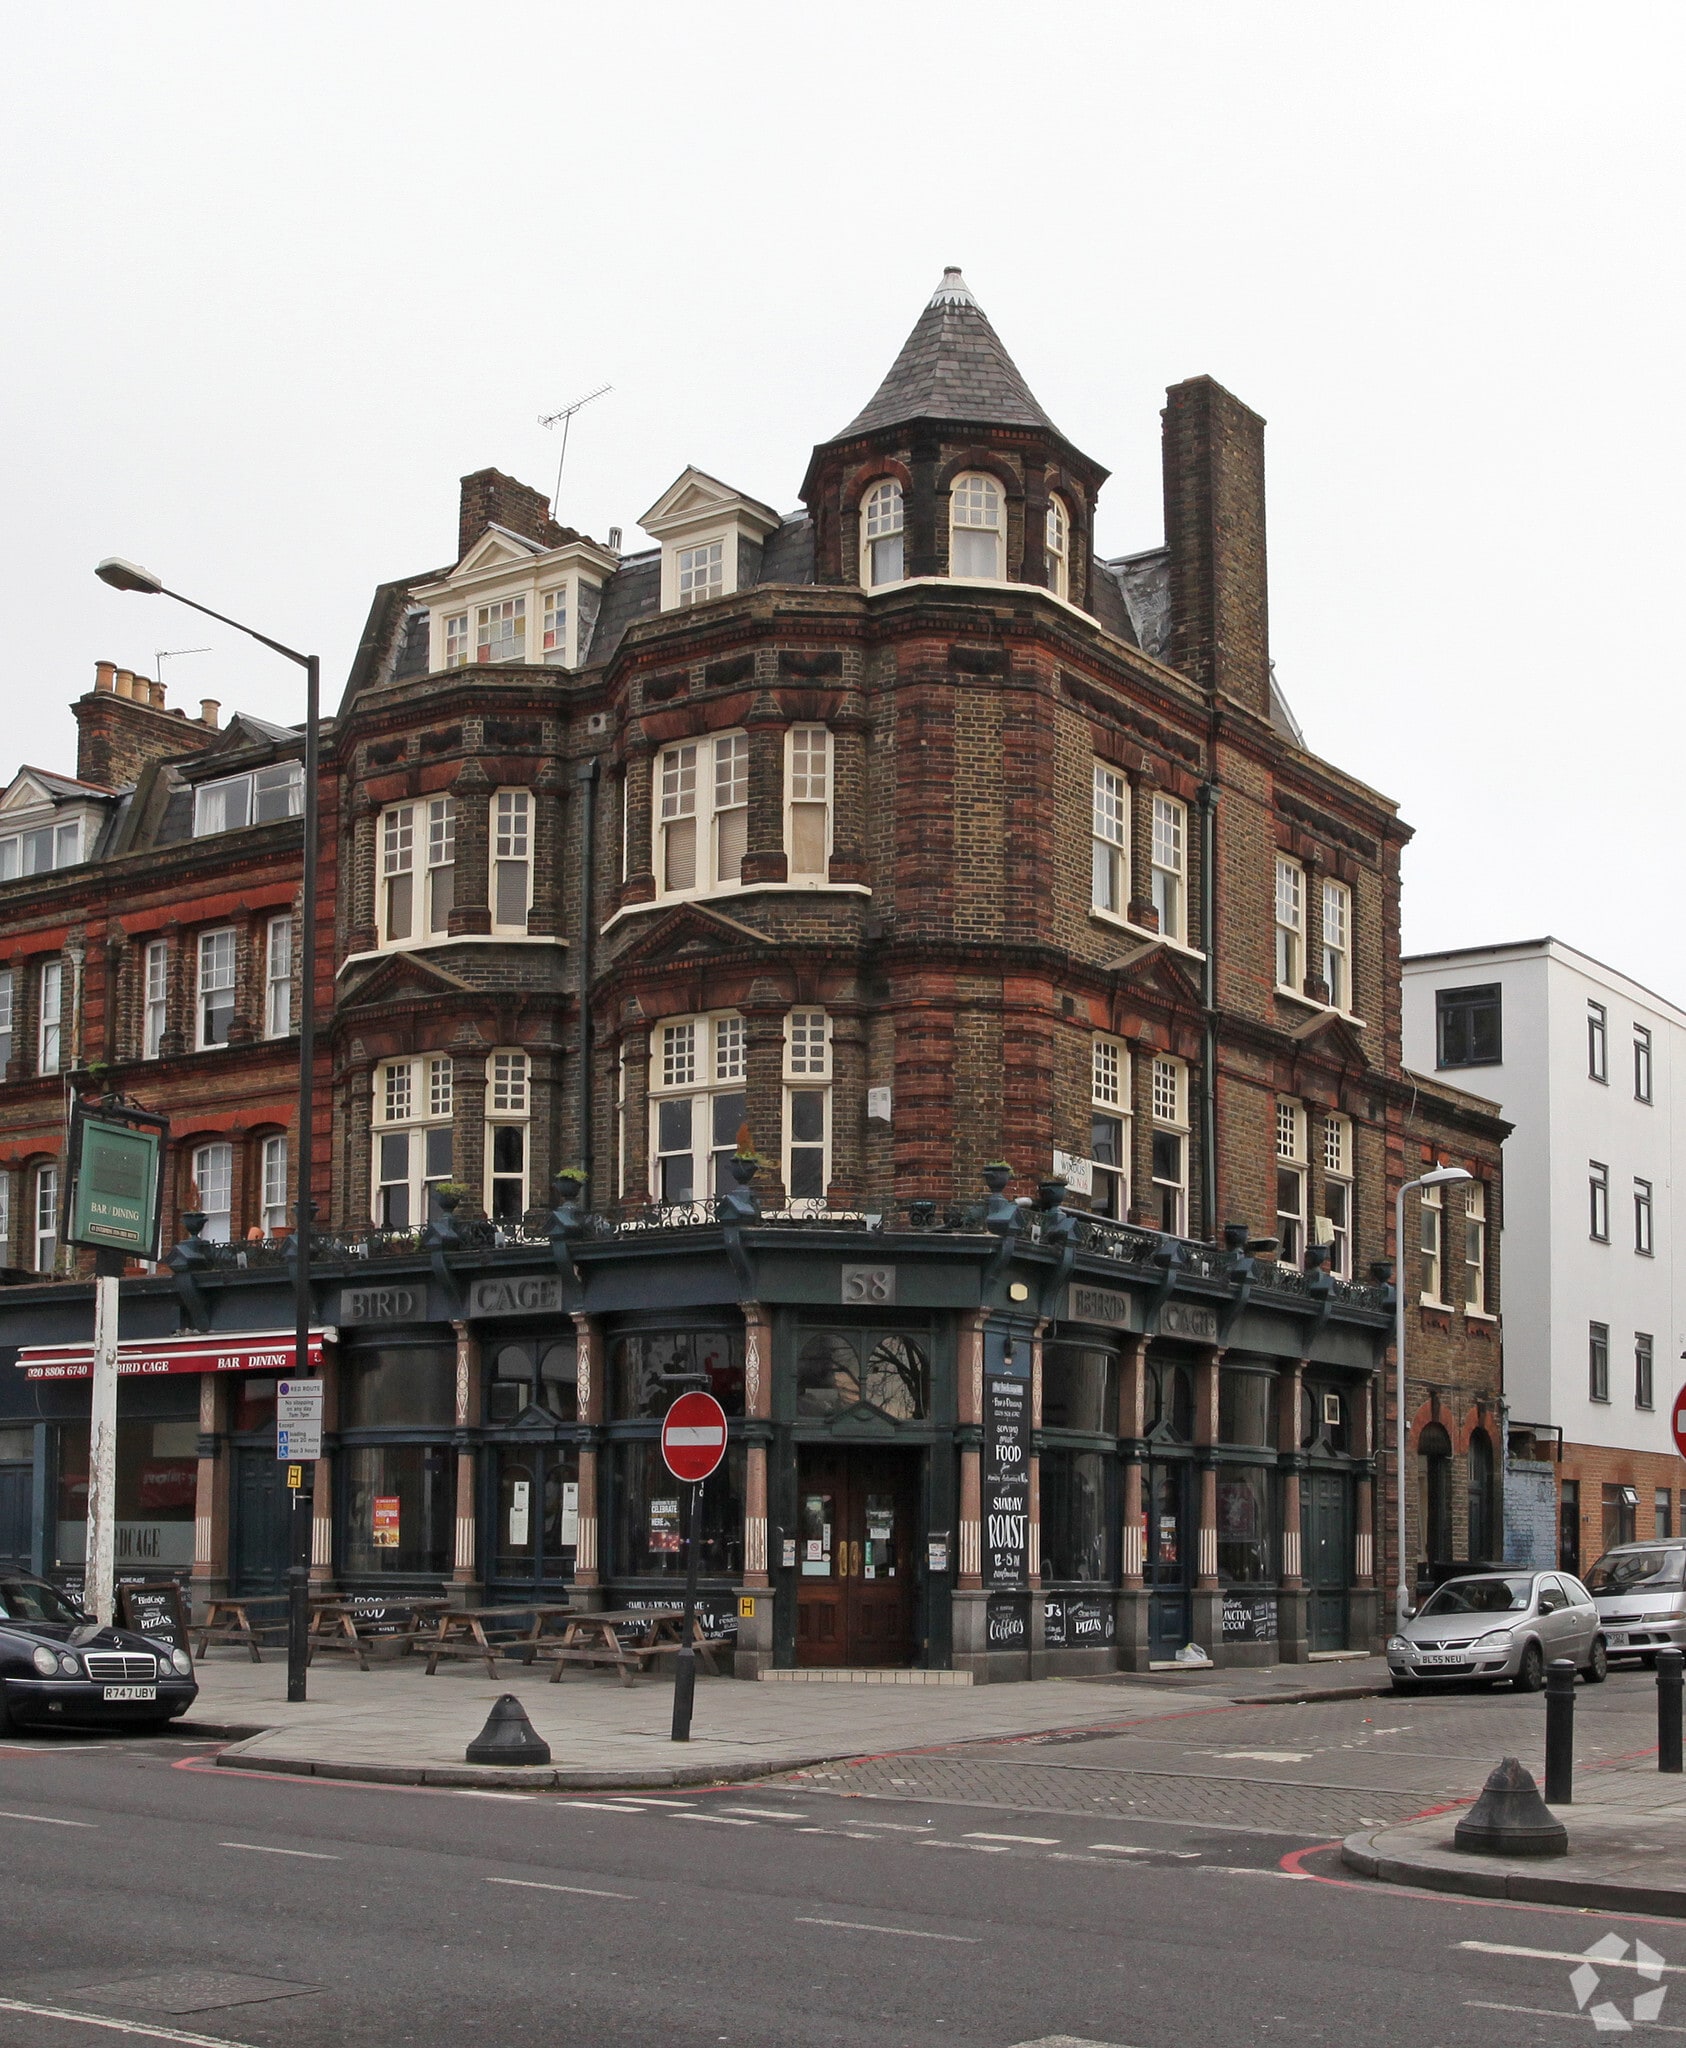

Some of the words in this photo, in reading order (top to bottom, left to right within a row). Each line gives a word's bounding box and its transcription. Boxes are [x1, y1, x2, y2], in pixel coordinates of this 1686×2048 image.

[91, 1202, 107, 1215] BAR
[112, 1206, 139, 1221] DINING
[846, 1271, 888, 1301] 58
[352, 1289, 413, 1319] BIRD
[477, 1280, 558, 1312] CAGE
[1075, 1289, 1127, 1321] BIRD
[142, 1360, 169, 1372] CAGE
[217, 1357, 240, 1369] BAR
[248, 1353, 287, 1367] DINING
[27, 1368, 43, 1378] 020
[44, 1366, 65, 1377] 8806
[66, 1365, 88, 1376] 6740
[995, 1444, 1022, 1463] FOOD
[290, 1468, 299, 1486] H
[992, 1496, 1023, 1512] SUNDAY
[987, 1514, 1028, 1549] ROAST
[114, 1527, 161, 1558] DCAGE
[671, 1601, 705, 1611] WELME
[741, 1599, 753, 1615] H
[140, 1615, 172, 1630] PIZZAS
[1075, 1618, 1102, 1634] PIZZAS
[105, 1687, 134, 1698] R747
[135, 1687, 155, 1698] UBY
